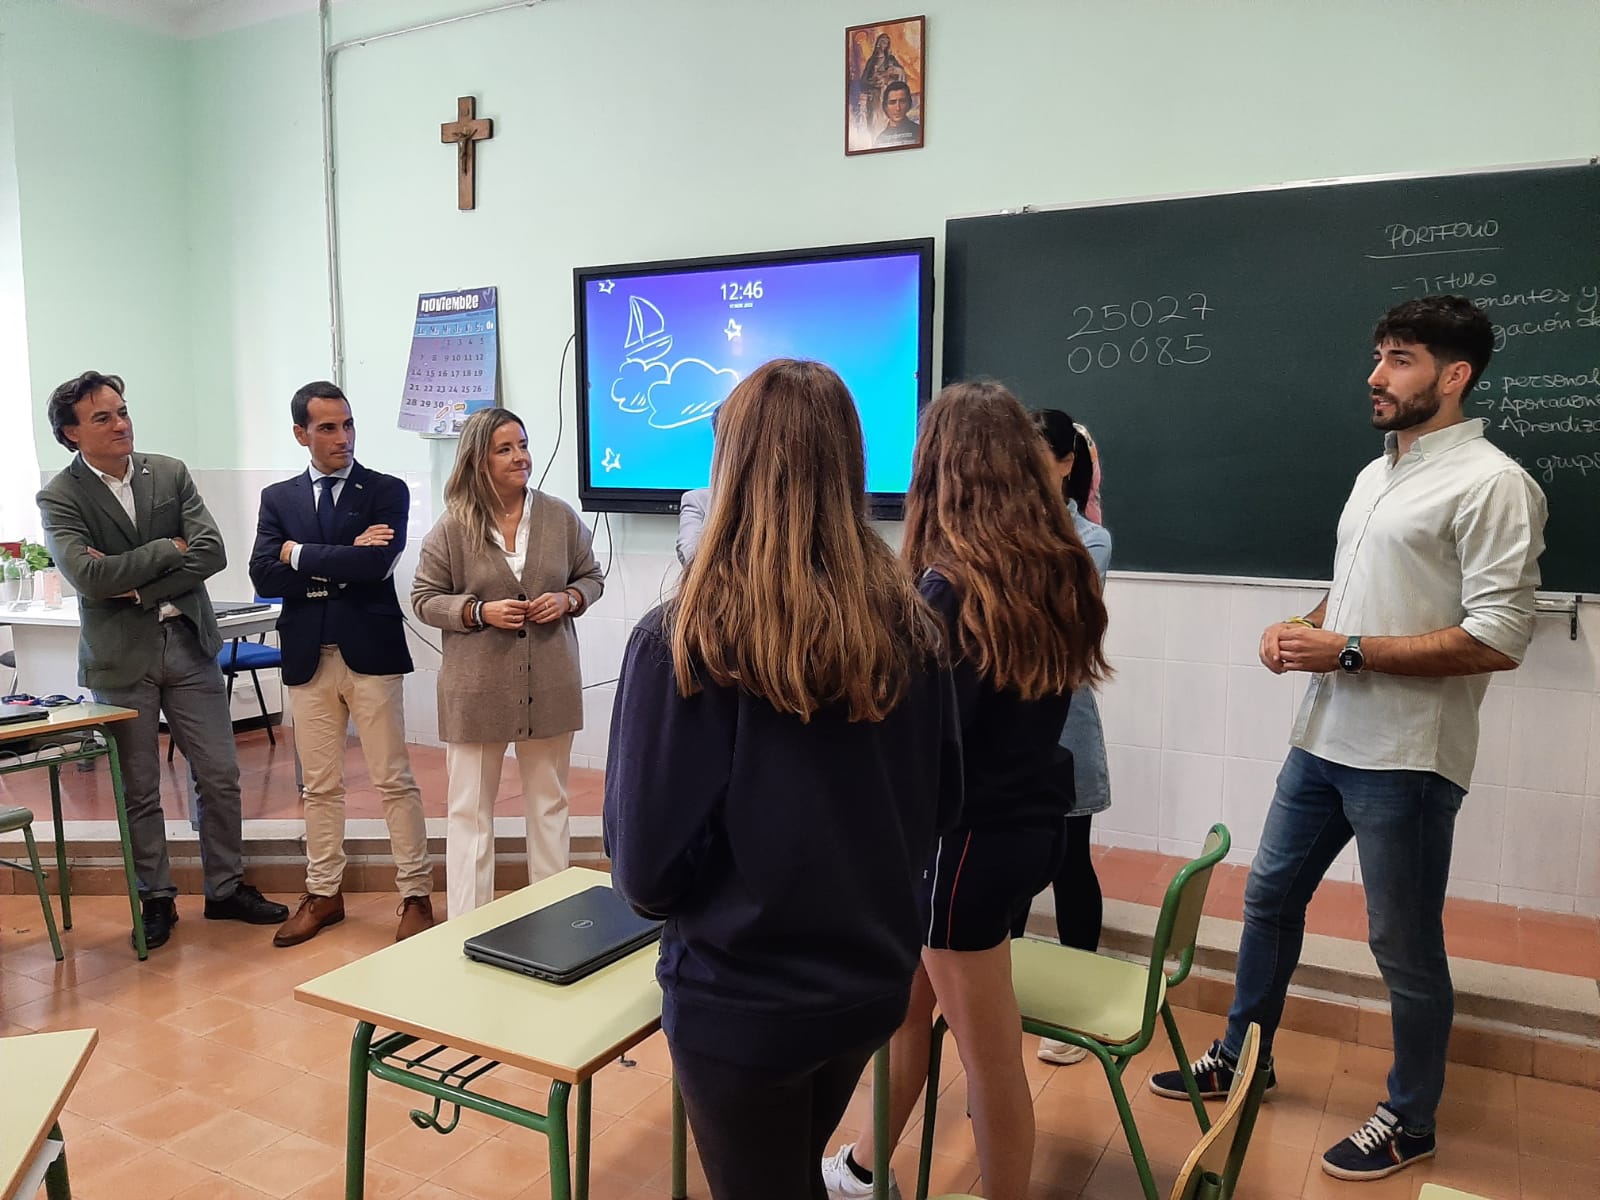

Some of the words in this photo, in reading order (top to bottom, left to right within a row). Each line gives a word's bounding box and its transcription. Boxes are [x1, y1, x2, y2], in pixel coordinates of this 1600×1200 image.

[720, 280, 764, 301] 12:46
[1474, 288, 1571, 309] onentes
[1577, 286, 1598, 312] y
[1066, 293, 1216, 340] 25027
[1491, 311, 1571, 352] gación
[1067, 334, 1212, 374] 00085
[409, 383, 419, 391] 21
[436, 385, 446, 393] 23
[448, 385, 458, 393] 24
[461, 385, 470, 393] 25
[472, 385, 482, 393] 26
[406, 398, 417, 406] 28
